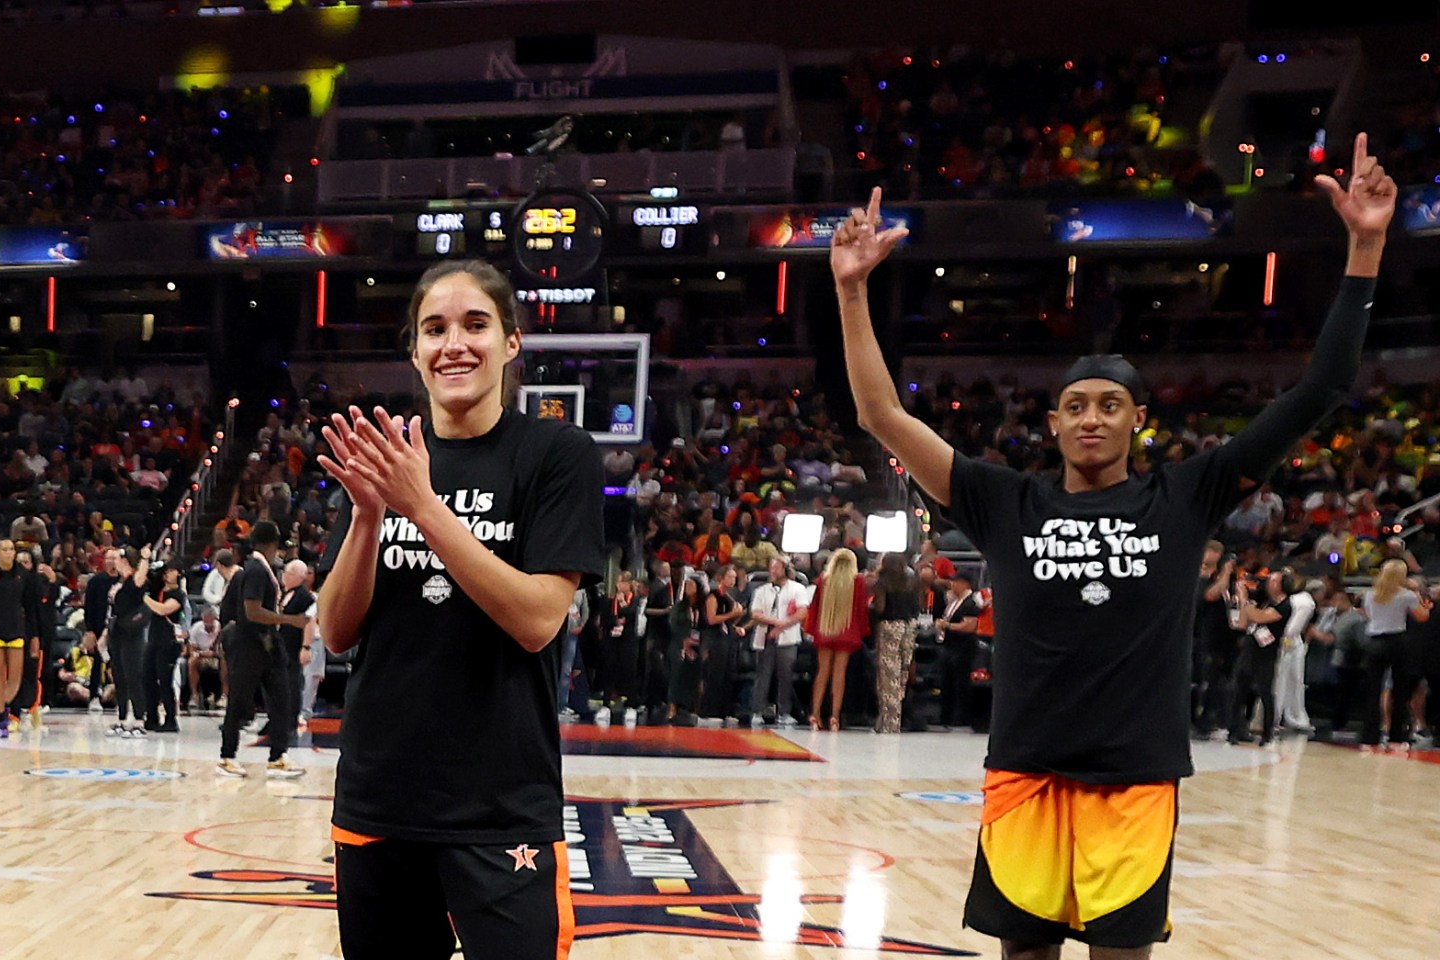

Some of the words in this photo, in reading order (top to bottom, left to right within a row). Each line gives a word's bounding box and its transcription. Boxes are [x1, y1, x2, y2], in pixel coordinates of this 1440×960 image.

[514, 80, 593, 98] FLIGHT
[417, 212, 464, 232] CLARK
[632, 206, 699, 226] COLLIER
[537, 288, 596, 303] TISSOT
[454, 488, 494, 513] Us
[379, 516, 425, 543] Wh
[1041, 518, 1095, 542] Pay
[1022, 534, 1102, 558] What
[1104, 533, 1160, 555] You
[1033, 558, 1104, 581] Owe
[1108, 555, 1148, 578] Us
